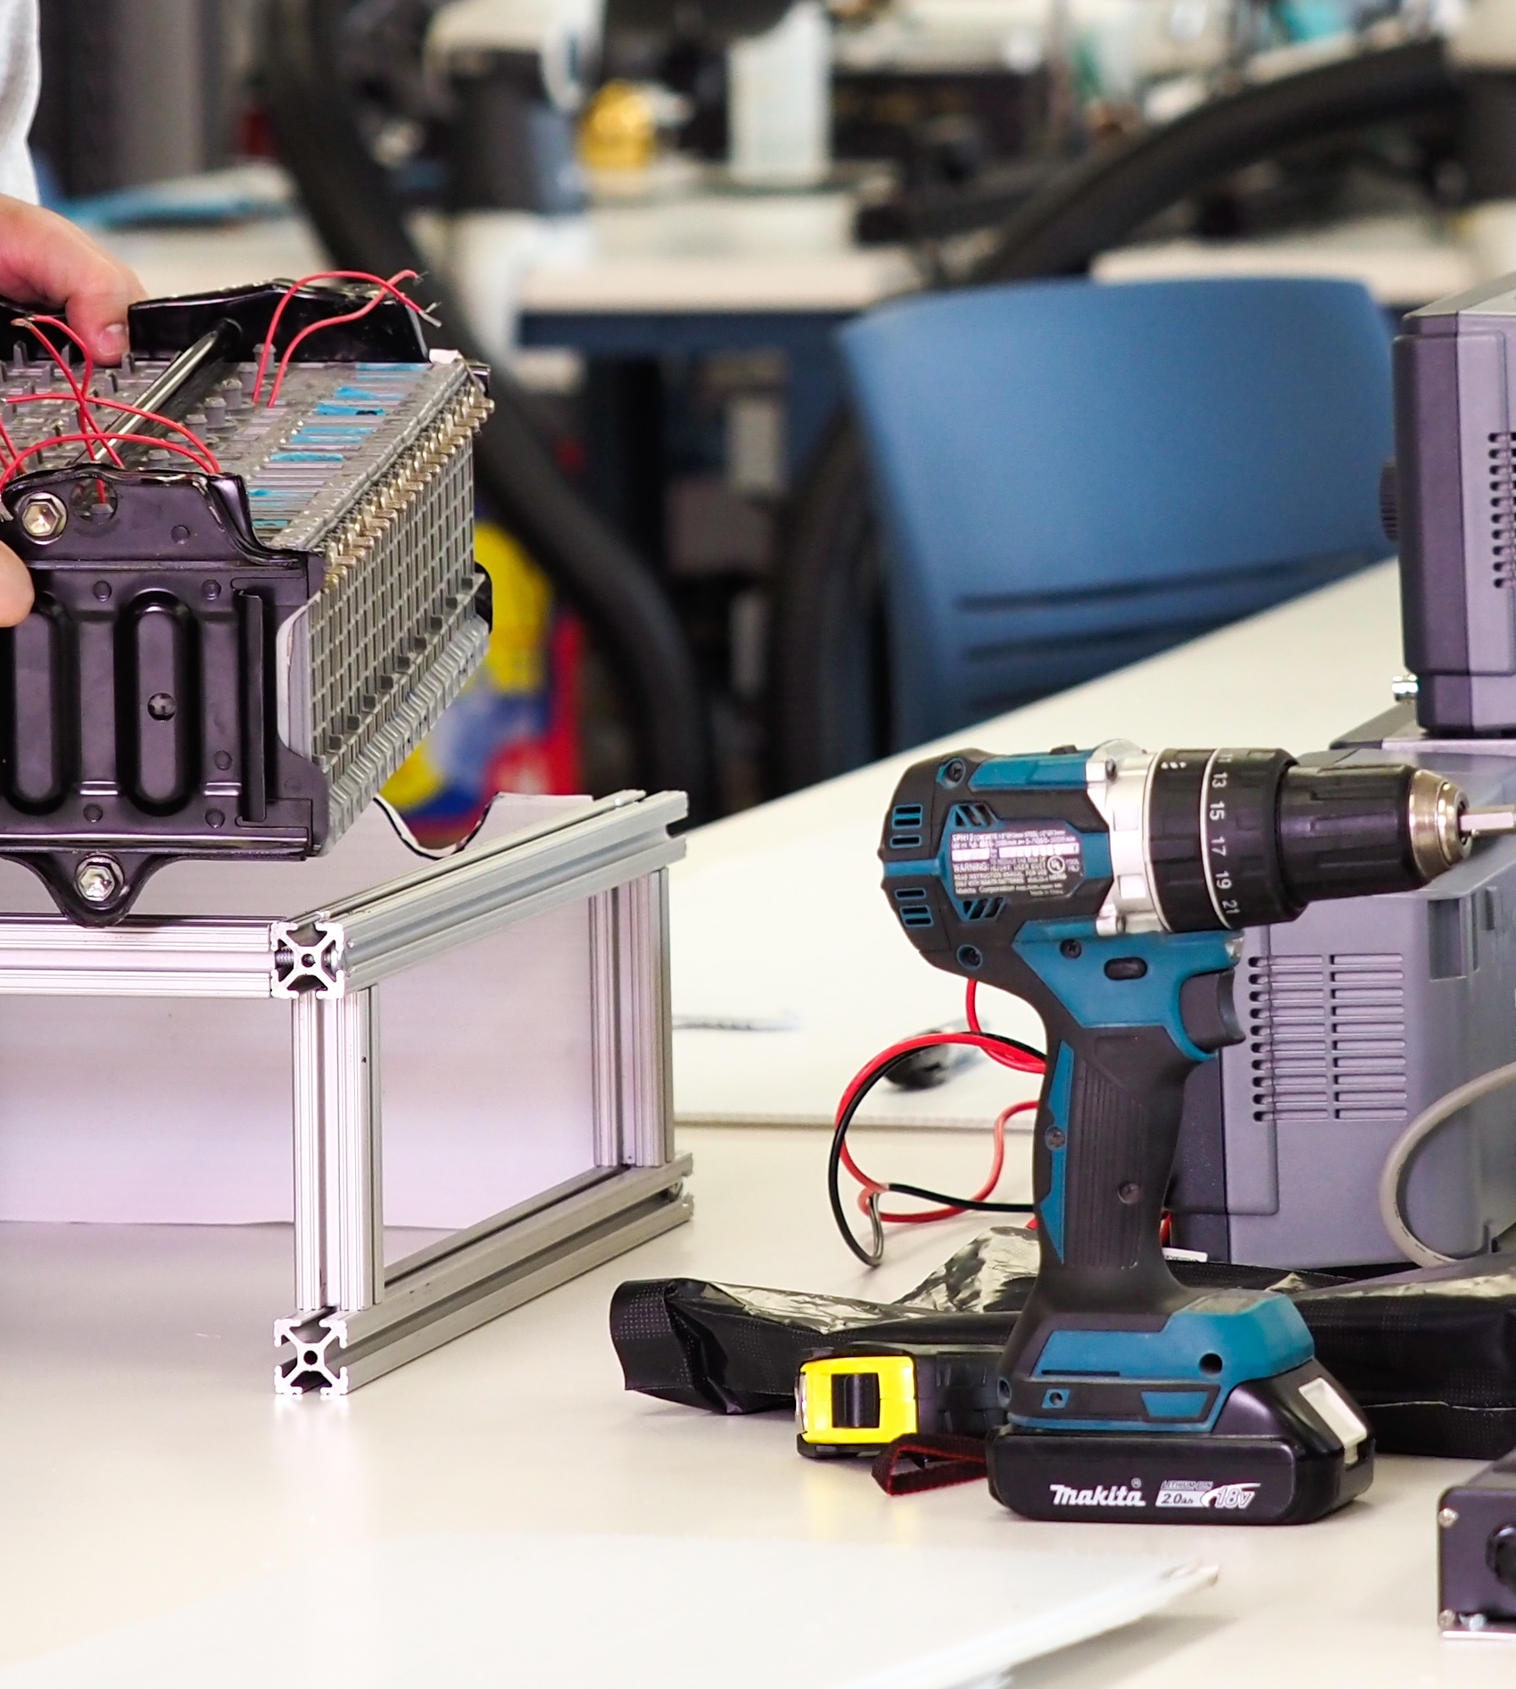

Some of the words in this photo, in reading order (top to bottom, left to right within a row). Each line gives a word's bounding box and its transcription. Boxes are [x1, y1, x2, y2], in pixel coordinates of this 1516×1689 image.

[1211, 771, 1228, 789] 13
[1209, 801, 1225, 821] 15
[1211, 836, 1227, 857] 17
[1215, 870, 1232, 890] 19
[1222, 900, 1241, 914] 21
